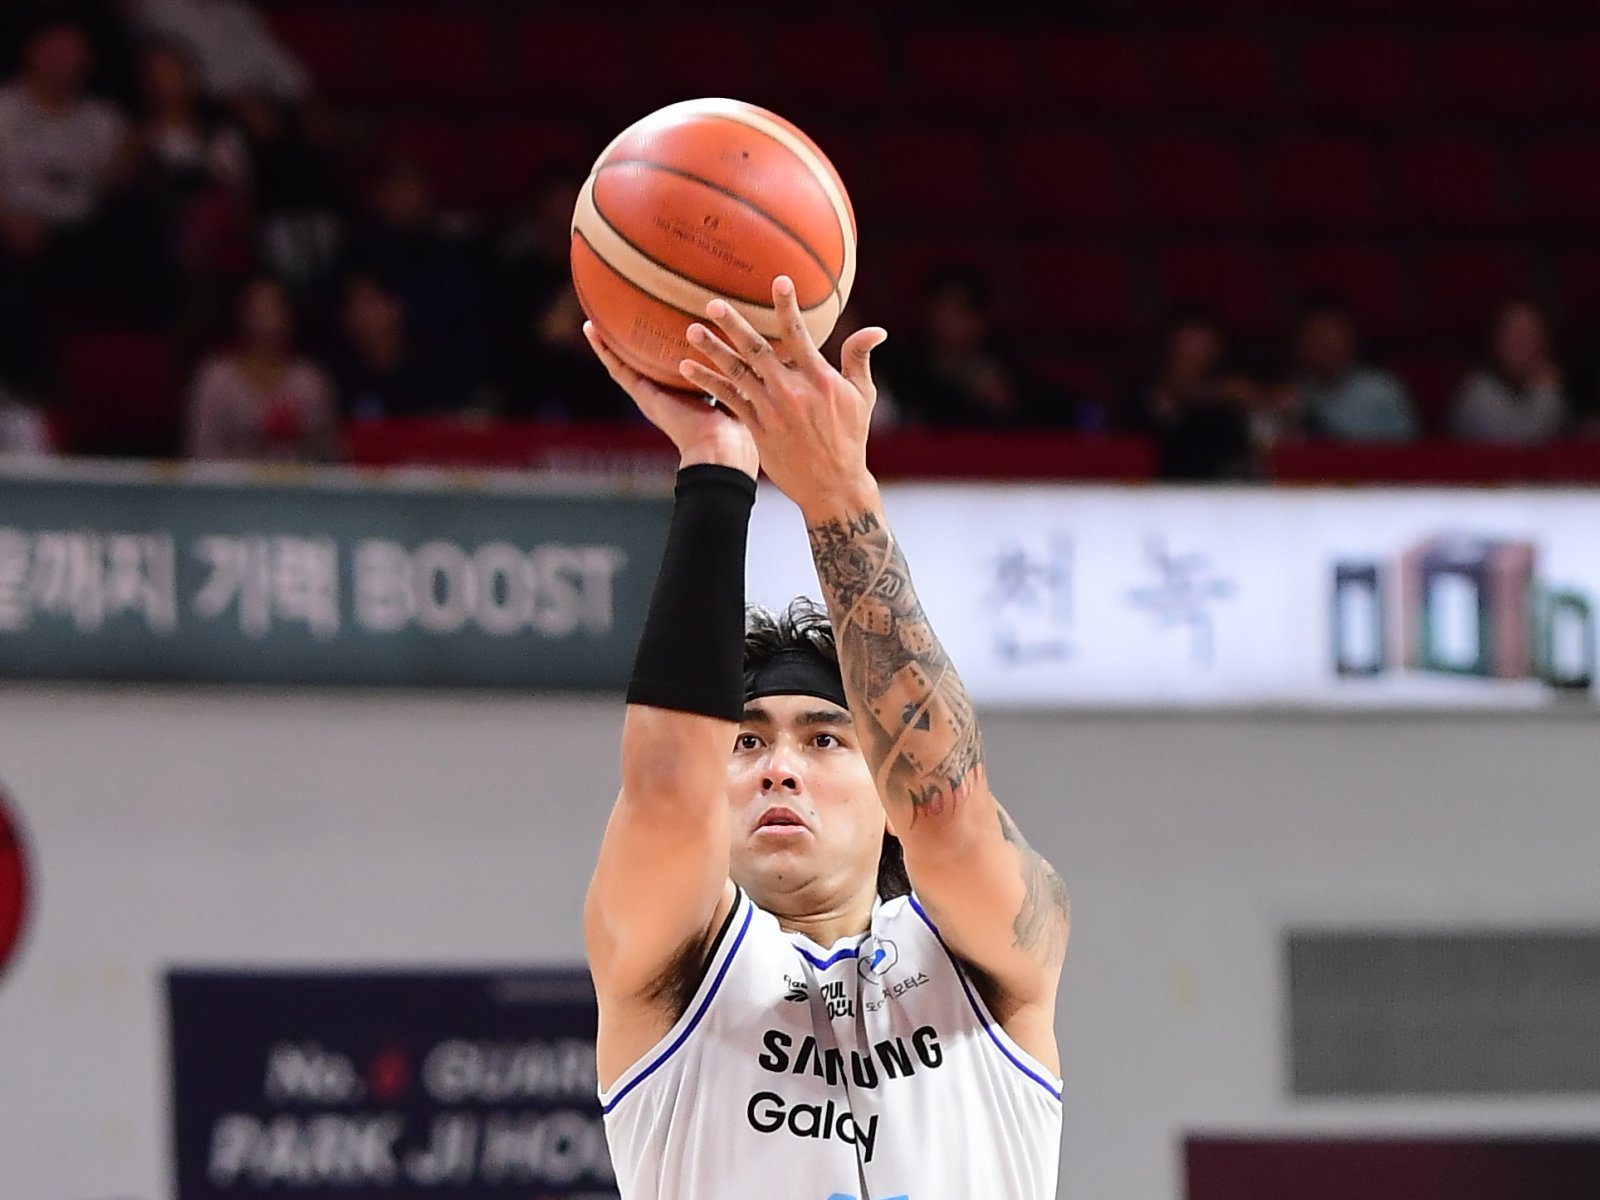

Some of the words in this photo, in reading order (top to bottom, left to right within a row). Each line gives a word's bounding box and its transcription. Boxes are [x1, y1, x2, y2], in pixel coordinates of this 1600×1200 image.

[354, 541, 623, 635] BOOST
[422, 1040, 597, 1102] GUAR
[208, 1114, 402, 1184] PARK
[481, 1114, 612, 1184] HO
[747, 1091, 879, 1163] Galay
